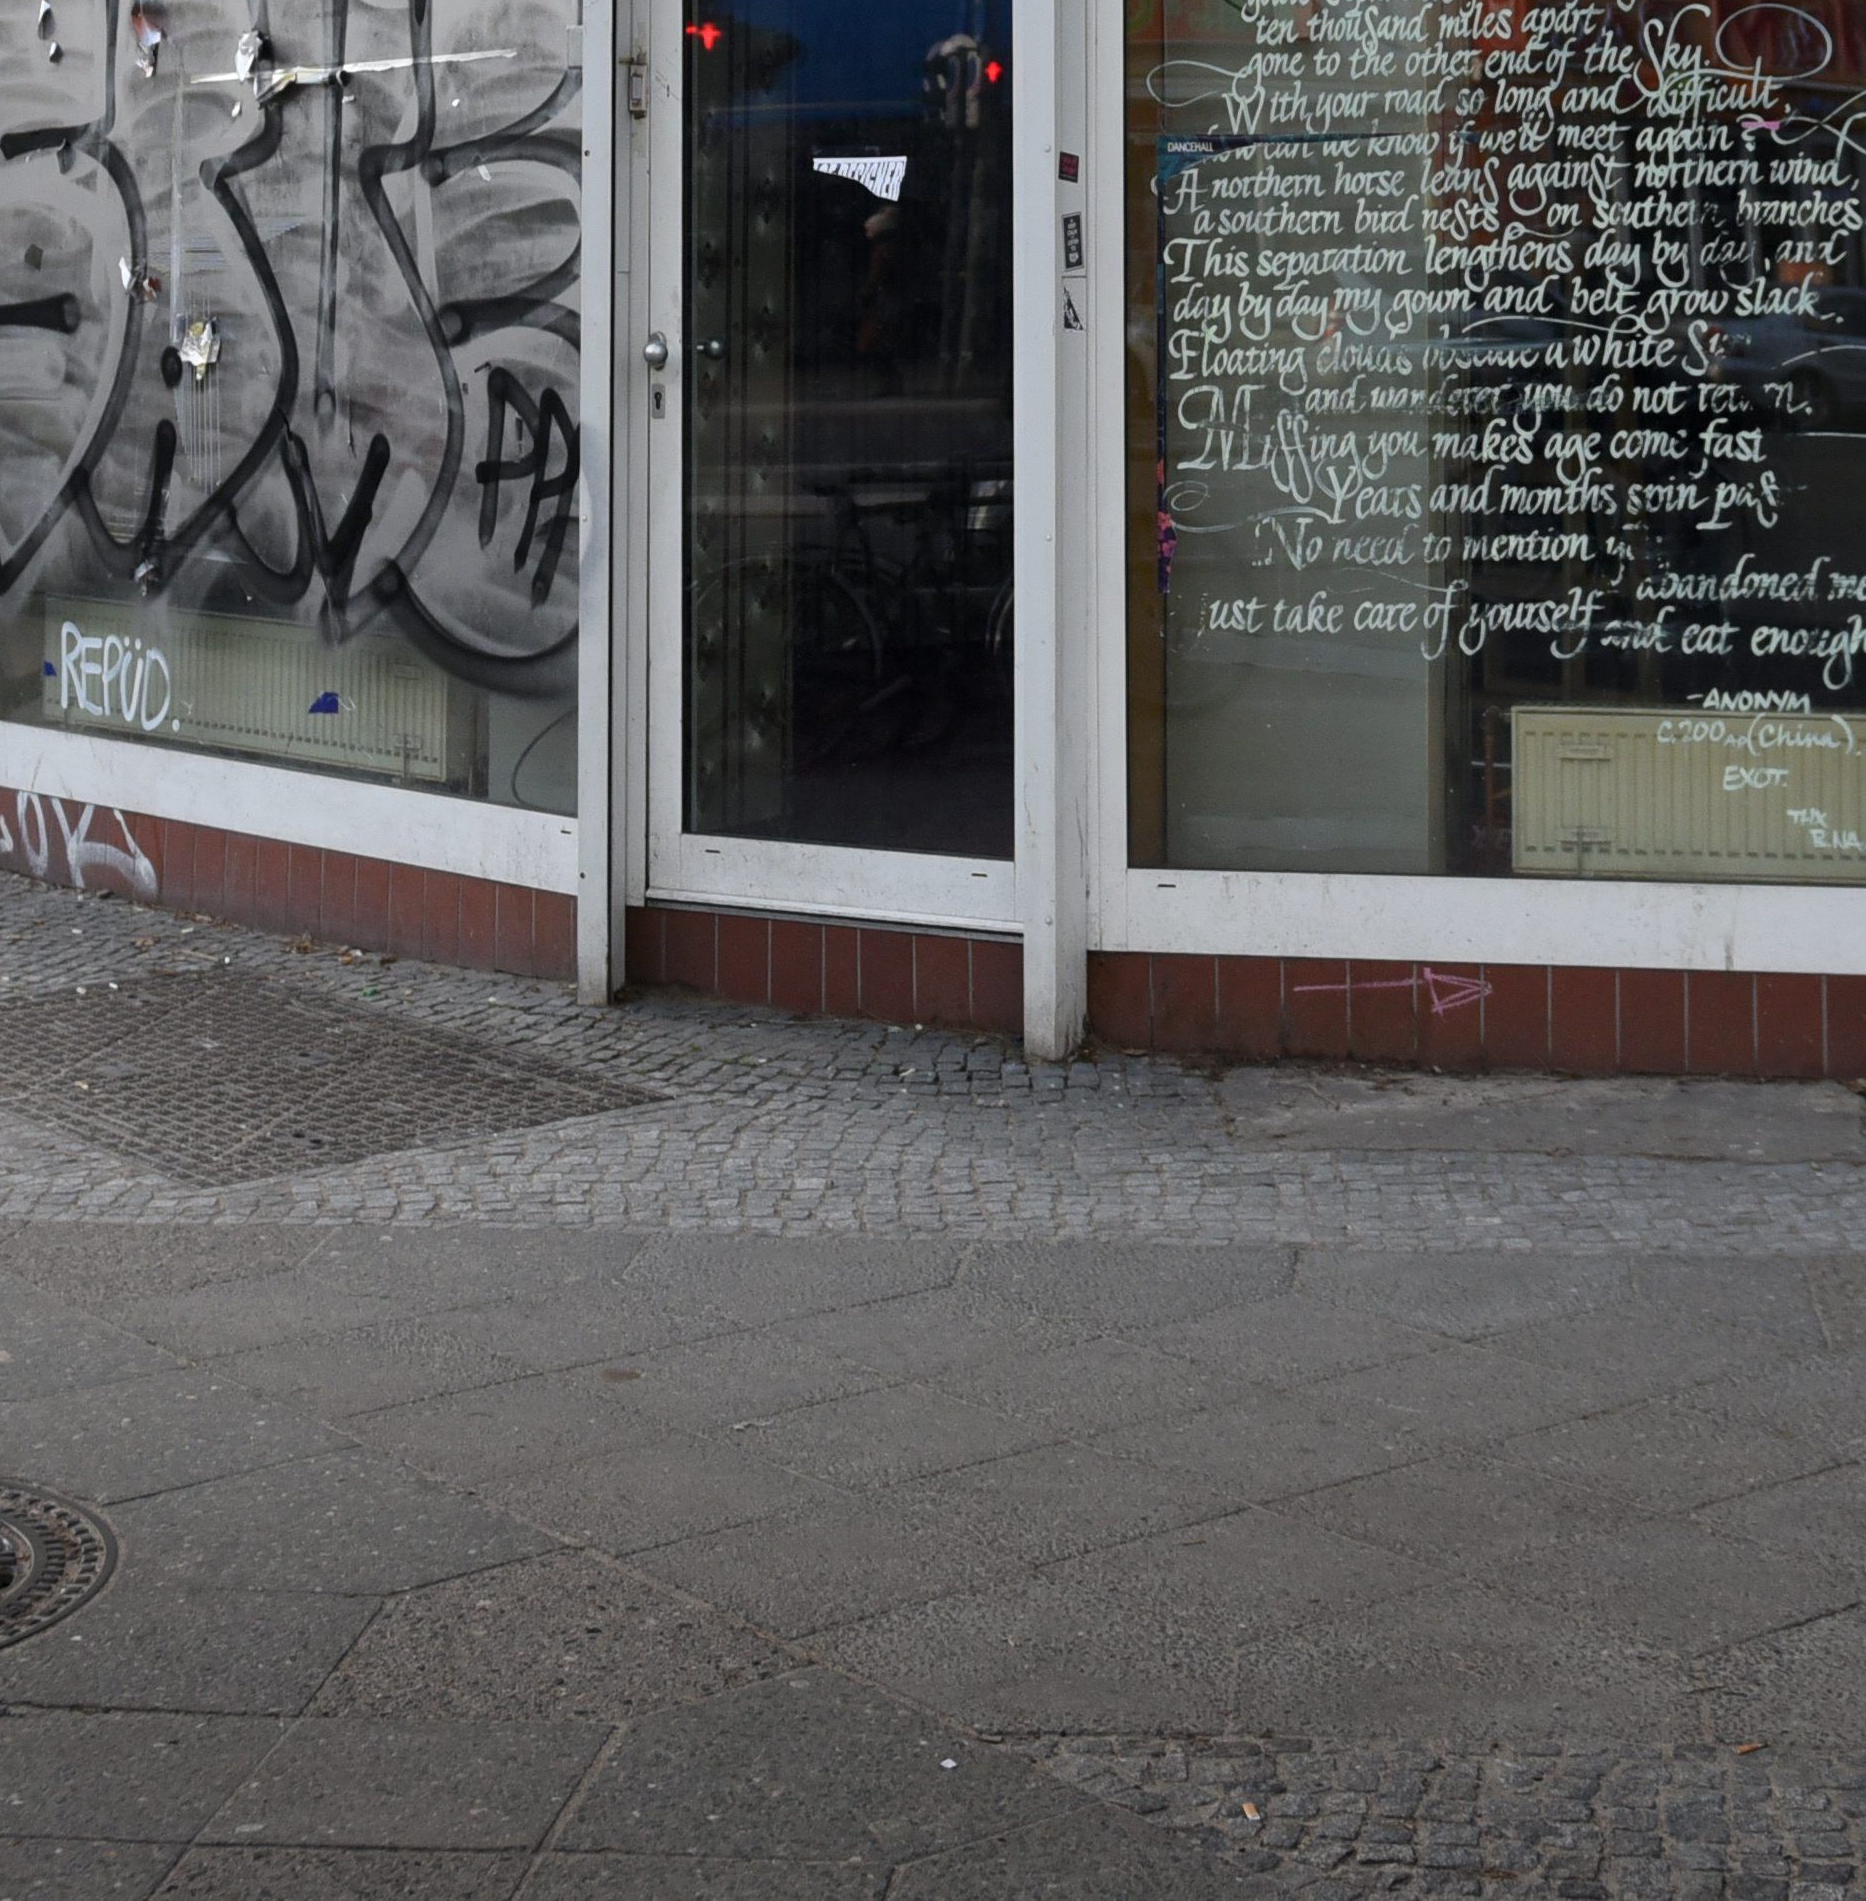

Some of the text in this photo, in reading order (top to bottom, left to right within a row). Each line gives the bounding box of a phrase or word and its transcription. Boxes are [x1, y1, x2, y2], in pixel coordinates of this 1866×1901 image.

[1255, 13, 1299, 46] ten
[1438, 2, 1513, 41] miles
[1313, 49, 1341, 77] to
[1349, 43, 1396, 80] the
[1404, 44, 1478, 79] other
[1484, 37, 1545, 79] end
[1546, 35, 1575, 90] of
[1583, 30, 1635, 75] the
[1221, 74, 1633, 139] With your road so long and
[1167, 141, 1214, 153] DANCEHALL
[1367, 119, 1440, 158] know
[1556, 121, 1632, 148] meet
[1150, 167, 1208, 216] A
[1211, 166, 1326, 199] northern
[1333, 161, 1405, 197] horse
[1633, 151, 1763, 189] northern
[1193, 209, 1214, 236] a
[1217, 202, 1344, 237] southern
[1353, 195, 1420, 236] bird
[1546, 200, 1582, 228] on
[1163, 237, 1249, 284] This
[1256, 242, 1413, 292] separation
[1584, 228, 1642, 287] day
[1651, 230, 1691, 289] by
[1776, 228, 1850, 266] and
[1173, 282, 1232, 344] day
[1237, 282, 1273, 341] by
[1275, 279, 1330, 341] day
[1332, 286, 1382, 336] my
[1384, 286, 1476, 339] gown
[1483, 275, 1559, 315] and
[1570, 276, 1640, 315] belt
[1640, 289, 1730, 335] grow
[1168, 328, 1310, 397] Floating
[1571, 321, 1678, 370] white
[1304, 374, 1367, 414] and
[1514, 383, 1579, 433] you
[1585, 373, 1624, 413] do
[1633, 381, 1691, 414] not
[1361, 417, 1767, 486] you makes age fast
[1326, 464, 1618, 524] Years and months
[1333, 522, 1420, 566] need
[1422, 529, 1452, 564] to
[1462, 531, 1597, 563] mention
[1272, 579, 1741, 660] take care of yourself eat
